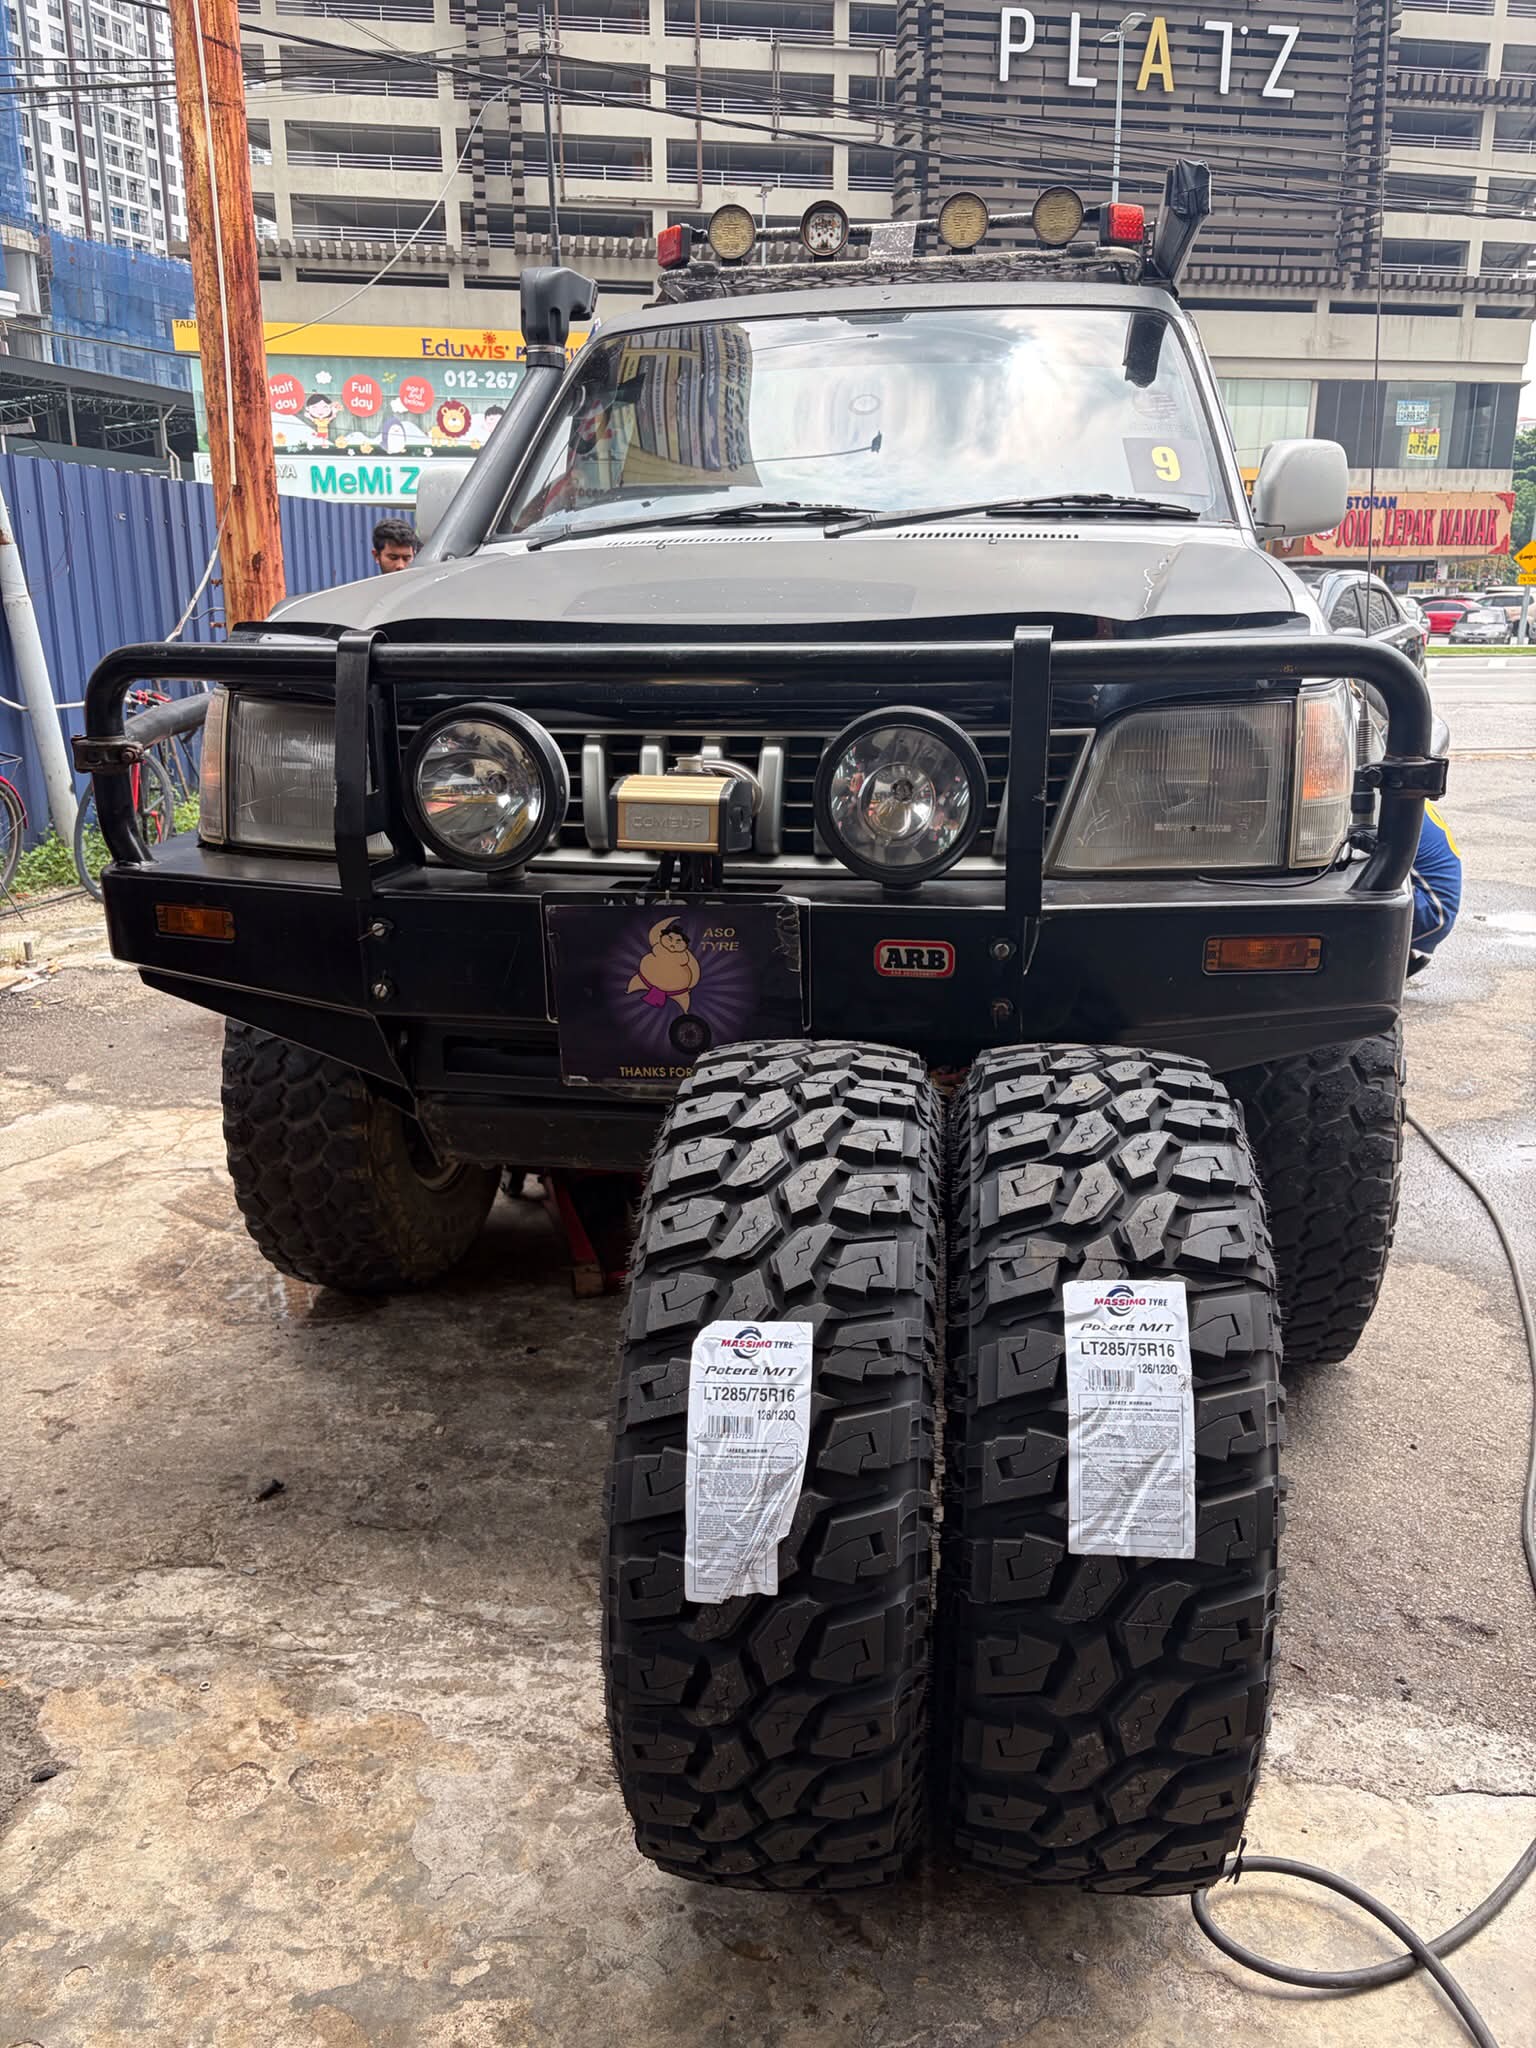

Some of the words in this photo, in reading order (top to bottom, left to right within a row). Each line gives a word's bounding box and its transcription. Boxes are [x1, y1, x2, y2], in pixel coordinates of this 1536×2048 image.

[270, 381, 294, 396] Half
[351, 382, 373, 394] Full
[275, 398, 298, 410] day
[351, 397, 374, 410] day
[1152, 446, 1181, 482] 9
[310, 465, 393, 495] MeMi
[1383, 509, 1437, 547] LEPAK
[1437, 509, 1500, 546] MAMAK
[703, 927, 736, 938] ASO
[700, 941, 740, 952] TYRE
[884, 948, 947, 970] ARB
[620, 1066, 667, 1078] THANKS
[1094, 1297, 1147, 1306] MASSIMO
[1149, 1298, 1169, 1307] TYRE
[1139, 1323, 1174, 1333] M/T
[720, 1339, 772, 1349] MASSIMO
[774, 1341, 794, 1349] TYRE
[1080, 1341, 1175, 1358] LT285/75R16
[705, 1366, 758, 1376] Potere
[762, 1366, 798, 1377] M/T
[1137, 1364, 1178, 1375] 126/123Q
[704, 1386, 796, 1403] LT285/75R16
[757, 1409, 796, 1421] 126/123Q
